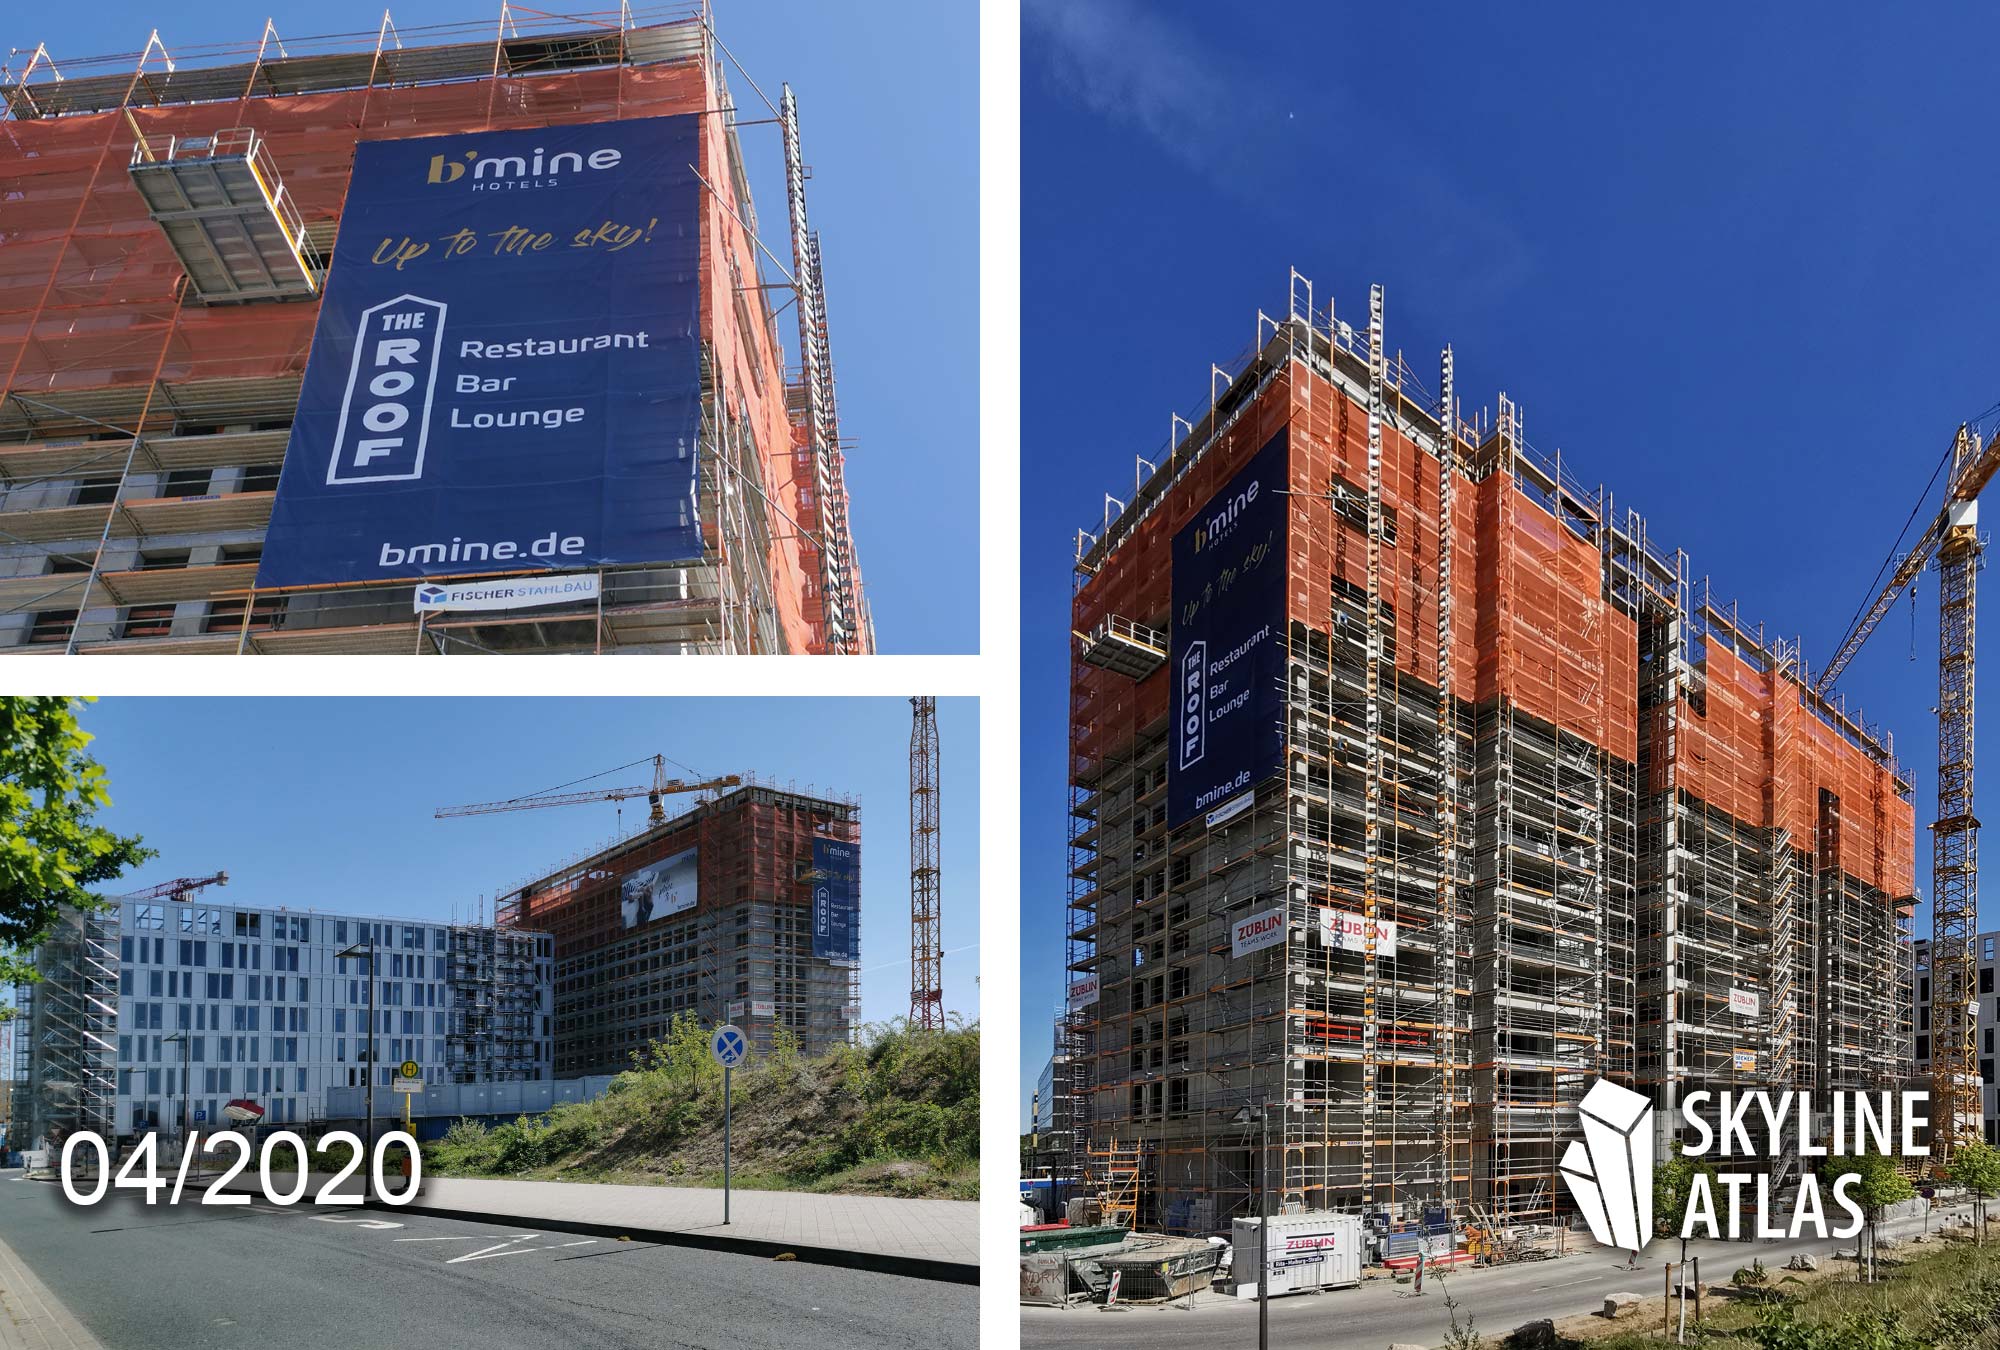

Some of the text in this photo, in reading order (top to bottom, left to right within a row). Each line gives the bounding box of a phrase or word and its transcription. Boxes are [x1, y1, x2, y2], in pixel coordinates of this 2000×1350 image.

[472, 178, 558, 191] HOTELS
[371, 217, 658, 271] Up to the sky!
[382, 312, 426, 331] THE
[460, 330, 649, 359] Restaurant
[455, 374, 517, 394] Bar
[353, 338, 420, 467] ROOF
[450, 406, 585, 429] Lounge
[1208, 521, 1239, 551] HOTELS
[379, 532, 585, 567] bmine.de
[451, 581, 593, 602] FISCHER STAHLBAU
[1187, 651, 1201, 670] THE
[1210, 624, 1270, 677] Restaurant
[1210, 679, 1229, 700] Bar
[1186, 670, 1200, 758] ROOF
[1209, 689, 1250, 722] Lounge
[1195, 770, 1250, 810] bmine.de
[1240, 931, 1277, 948] TEAMS WORK
[405, 1064, 414, 1074] H
[197, 1111, 203, 1119] P
